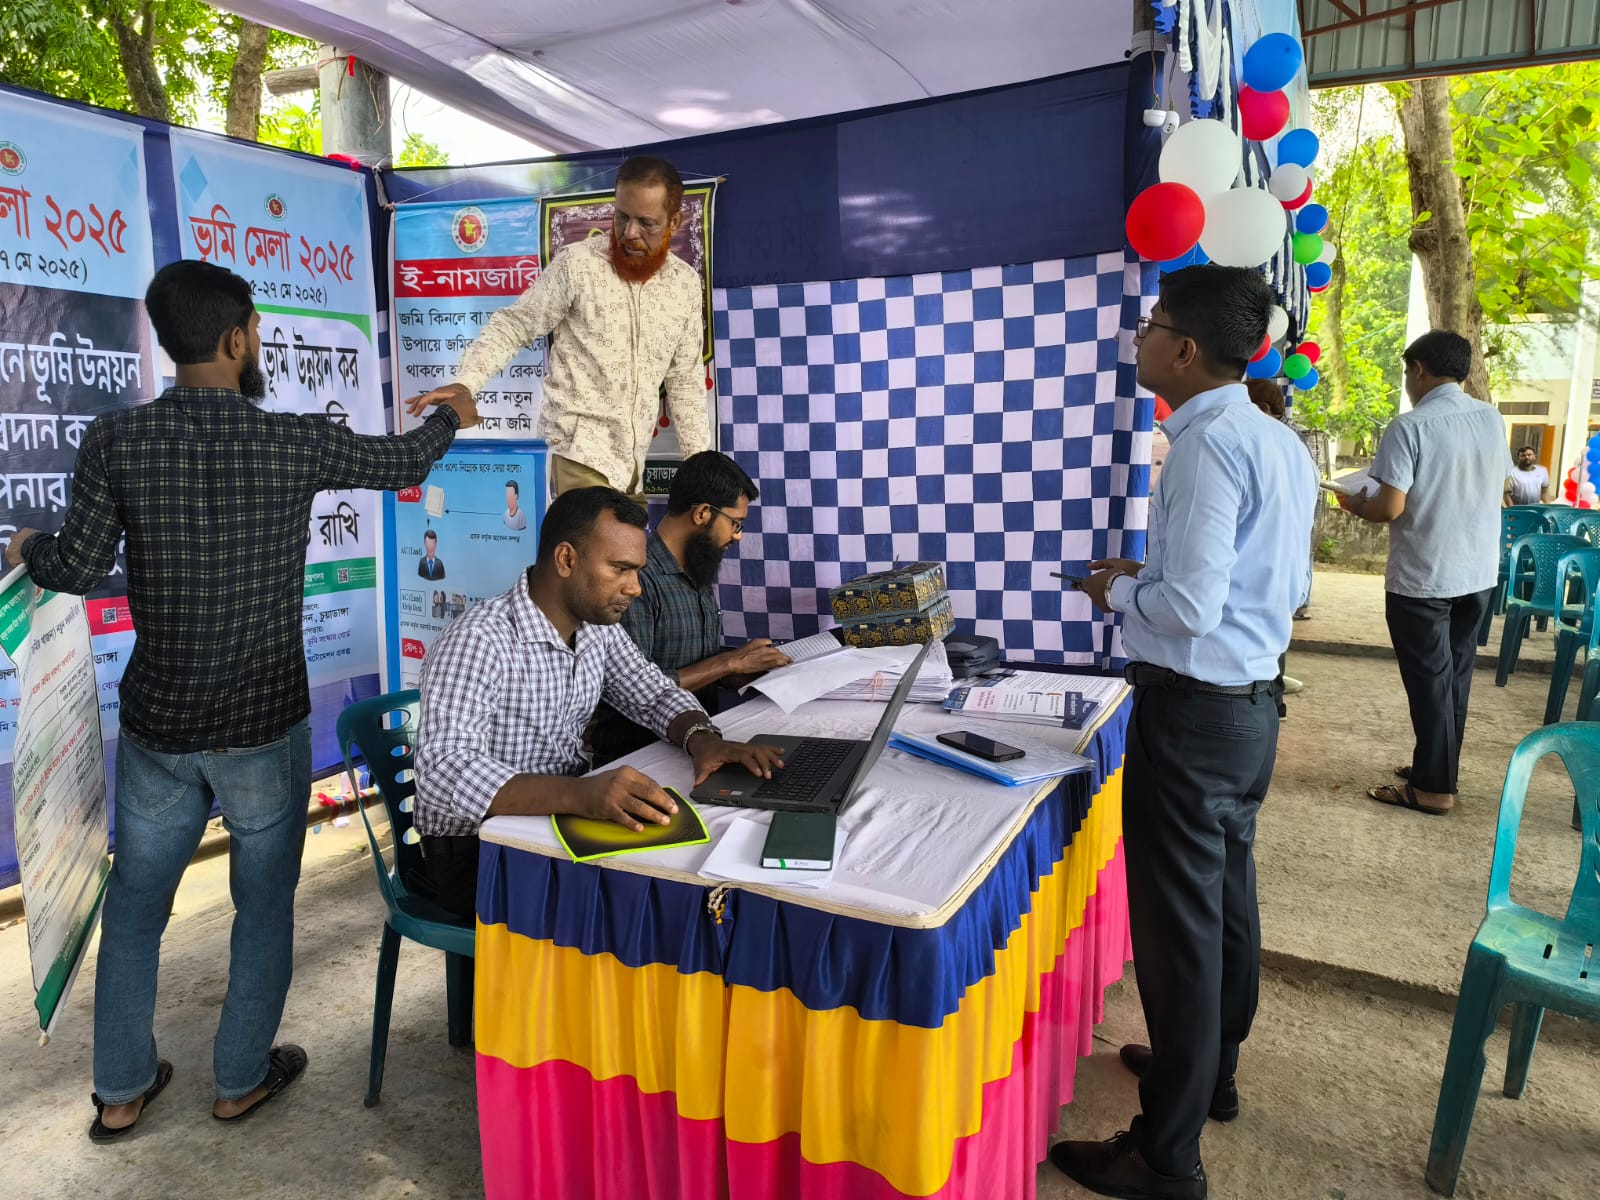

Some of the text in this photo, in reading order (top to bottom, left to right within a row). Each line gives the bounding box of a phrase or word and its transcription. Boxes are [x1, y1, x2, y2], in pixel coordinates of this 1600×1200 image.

[44, 194, 128, 258] ২০২৫
[15, 251, 32, 272] মে
[38, 253, 88, 285] ২০২৫)
[244, 226, 292, 272] মেলা
[299, 235, 355, 285] ২০২৫
[399, 260, 540, 292] ই-নামজারি
[280, 282, 292, 300] মে
[295, 284, 328, 308] ২০২৫)
[398, 308, 424, 327] জমি
[429, 308, 467, 327] কিনলে
[470, 310, 482, 326] বা
[401, 334, 441, 352] উপায়ে
[27, 331, 74, 405] ভূমি
[75, 333, 142, 394] উন্নয়ন
[261, 325, 360, 400] ভূমি উন্নয়ন কর
[406, 363, 445, 379] থাকলে
[509, 359, 544, 378] রেকর্ড
[502, 391, 534, 409] নতুন
[505, 412, 532, 431] জমি
[317, 501, 360, 547] রাখি
[94, 651, 119, 664] ডাঙ্গা
